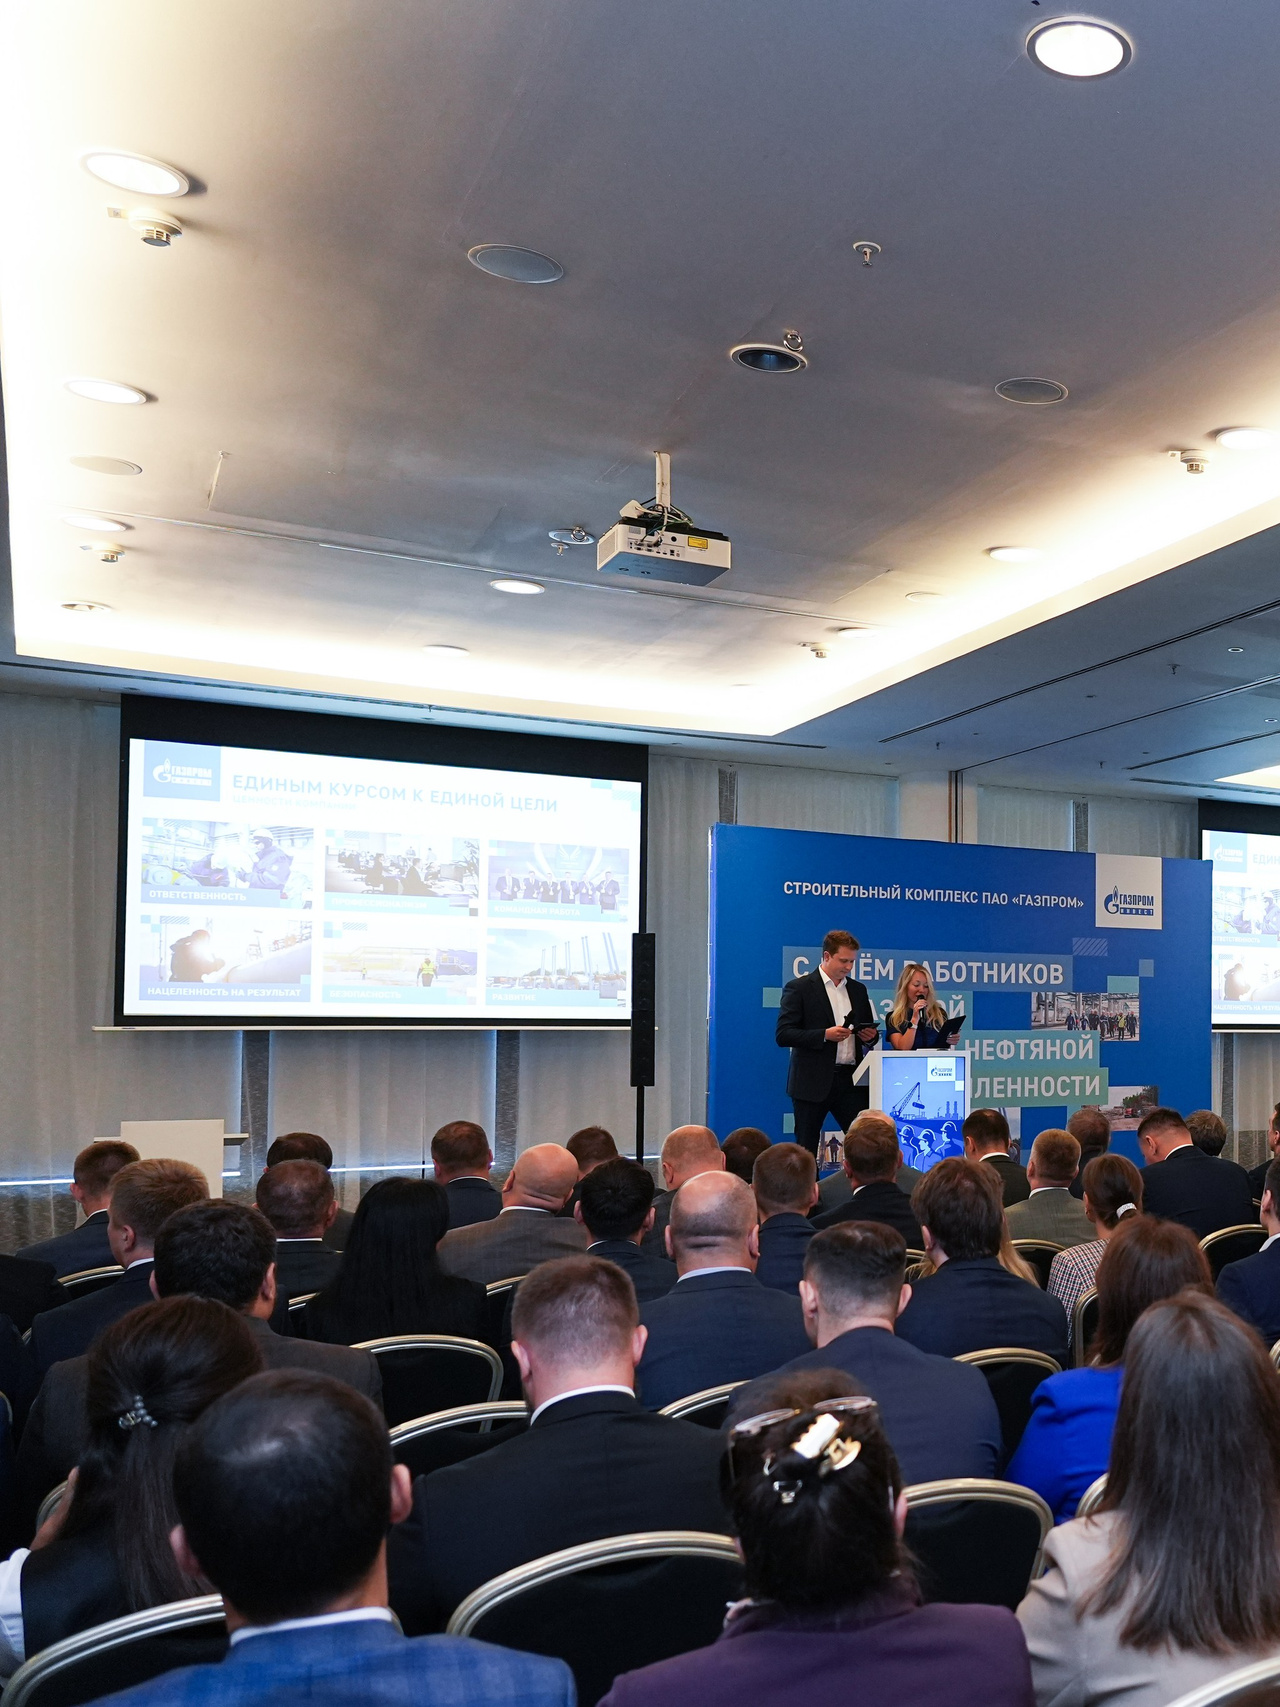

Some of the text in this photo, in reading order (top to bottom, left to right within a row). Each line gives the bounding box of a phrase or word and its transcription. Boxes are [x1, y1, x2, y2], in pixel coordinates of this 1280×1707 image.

[232, 774, 322, 794] ЕДИНЫМ
[329, 781, 406, 801] КУРСОМ
[413, 788, 423, 802] К
[430, 789, 505, 808] ЕДИНОЙ
[510, 796, 558, 812] ЦЕЛИ
[149, 889, 247, 901] ОТВЕТСТВЕННОСТЬ
[783, 881, 1085, 908] СТРОИТЕЛЬНЫЙ КОМПЛЕКС ПАО «ГАЗПРОМ»
[1119, 894, 1154, 906] ГАЗПРОМ
[494, 905, 580, 916] КОМАНДНАЯ РАБОТА
[792, 956, 810, 979] С
[903, 960, 1064, 985] АБОТНИКОВ
[148, 987, 302, 998] НАЦЕЛЕННОСТЬ НА РЕЗУЛЬТАТ
[329, 989, 402, 999] БЕЗОПАСНОСТЬ
[492, 993, 537, 1001] РАЗВИТИЕ
[965, 1034, 1093, 1060] НЕФТЯНОЙ
[970, 1075, 1100, 1099] ЛЕННОСТИ
